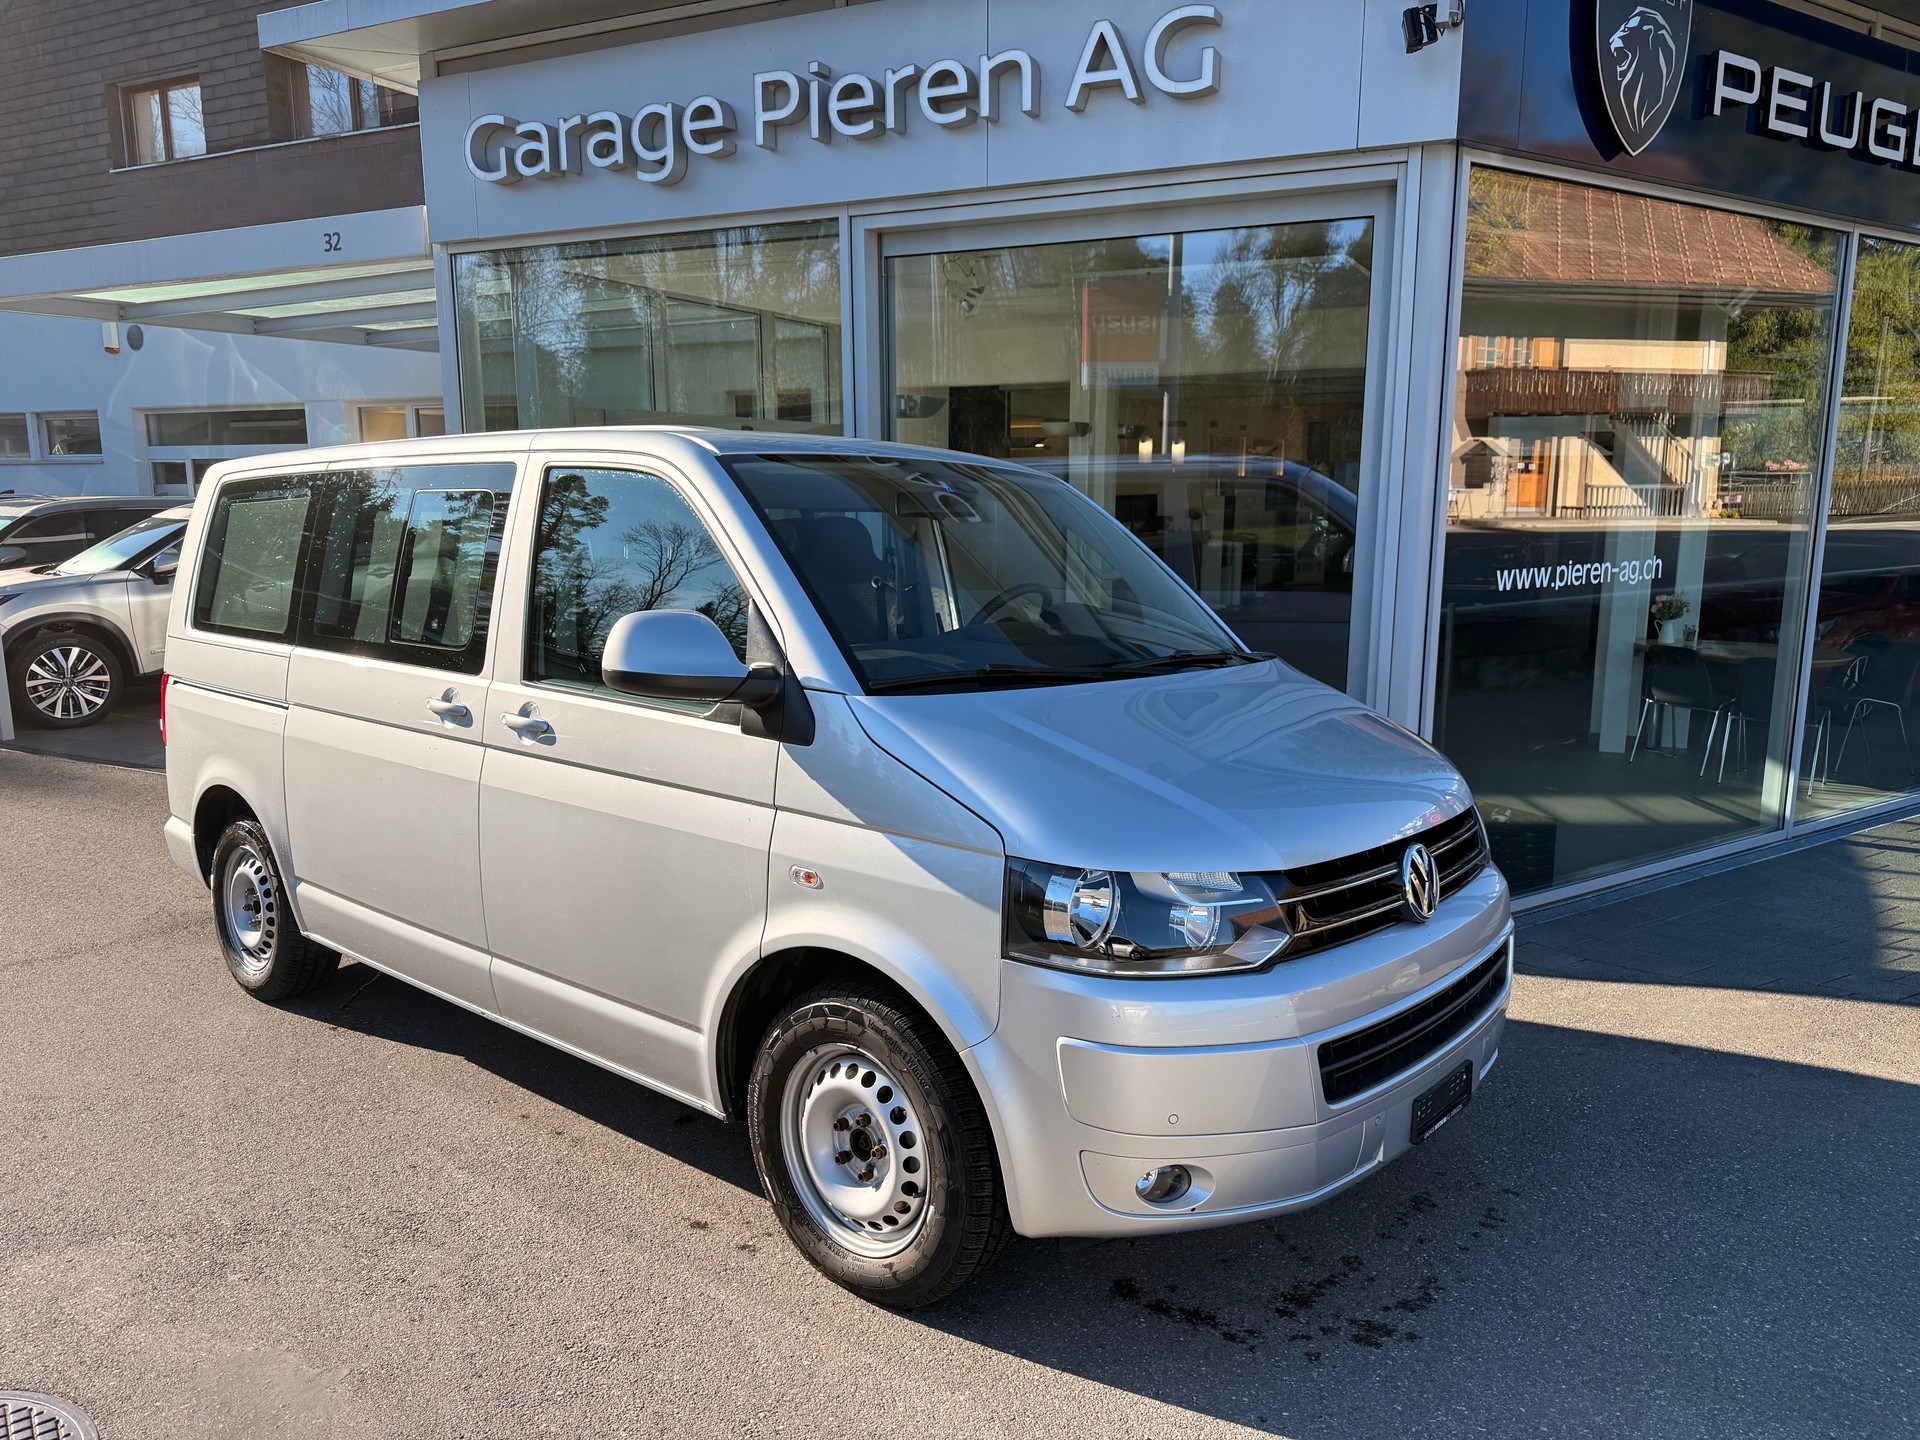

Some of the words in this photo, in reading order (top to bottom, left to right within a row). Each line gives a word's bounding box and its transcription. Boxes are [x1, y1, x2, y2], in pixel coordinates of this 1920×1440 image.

[463, 95, 737, 187] Garage
[753, 49, 1041, 150] Pieren
[1065, 3, 1222, 112] AG
[1713, 49, 1920, 167] PEUG
[323, 231, 342, 252] 32
[1496, 555, 1663, 592] www.pieren-ag.ch
